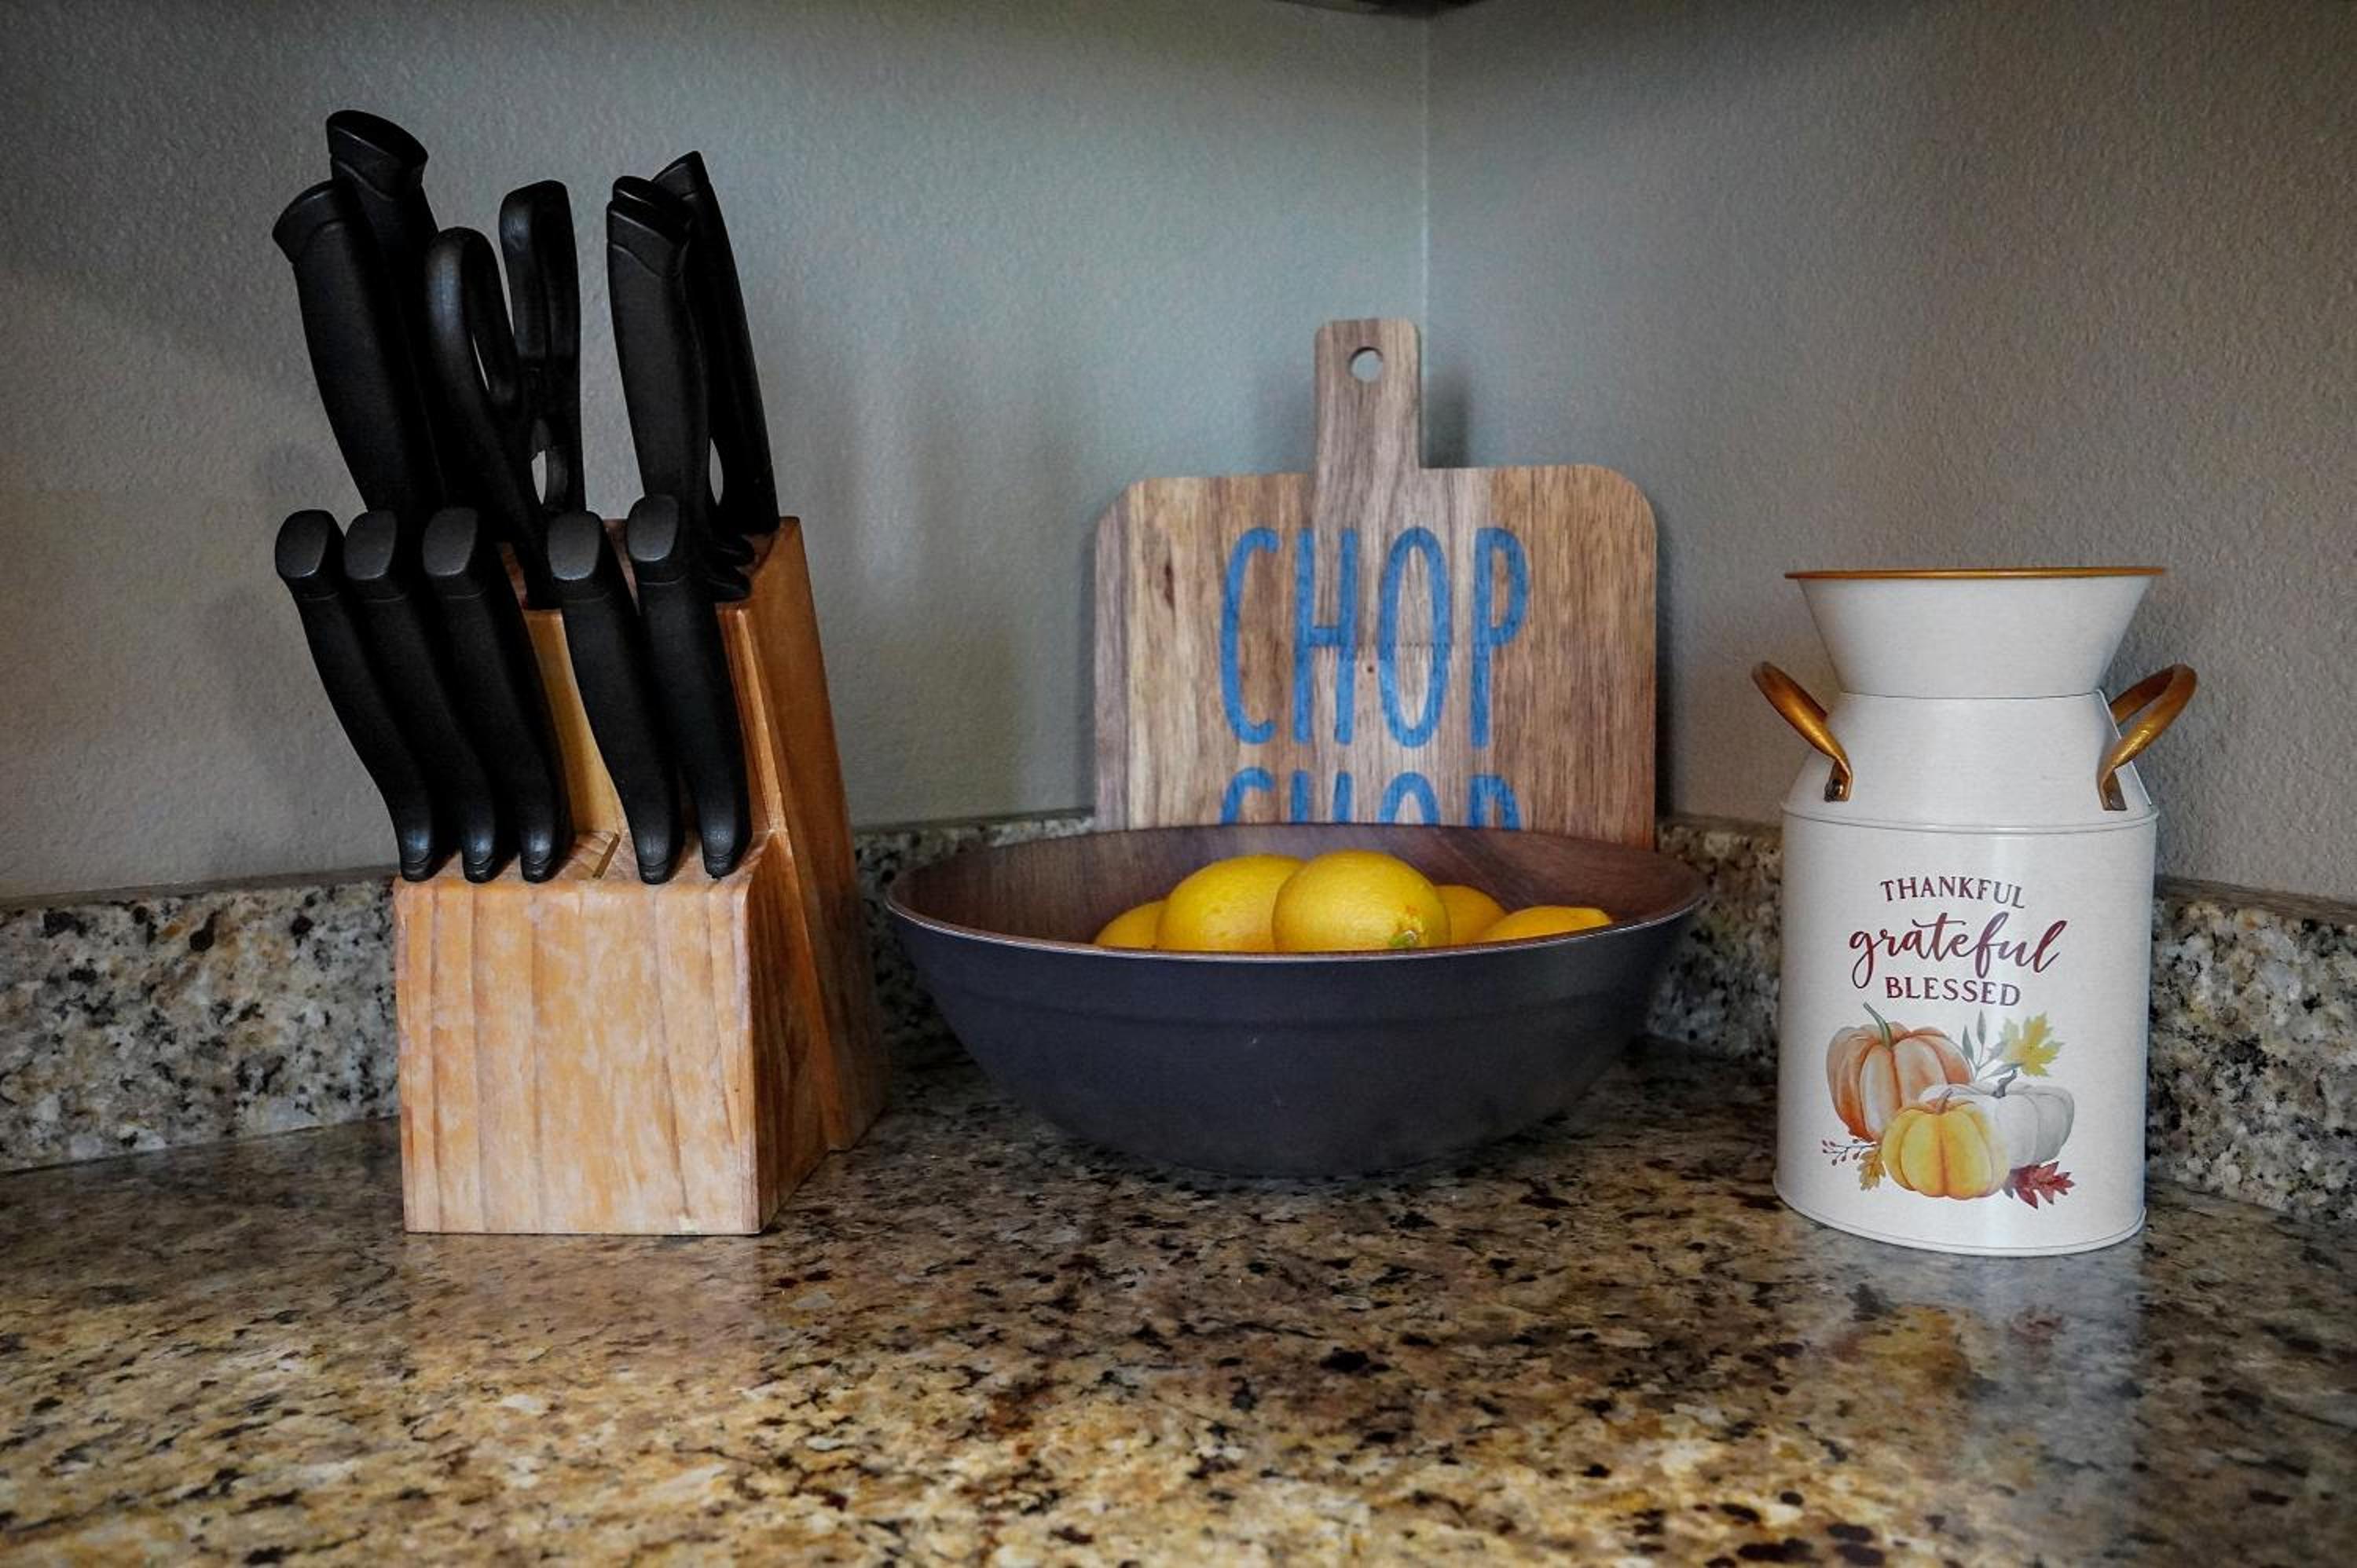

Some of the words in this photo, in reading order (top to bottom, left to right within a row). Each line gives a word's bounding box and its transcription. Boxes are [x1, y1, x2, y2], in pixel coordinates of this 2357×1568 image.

[1219, 526, 1530, 749] CHOP
[1880, 875, 2025, 909] THANKFUL
[1849, 910, 2068, 989] grateful
[1885, 976, 2022, 1006] BLESSED
